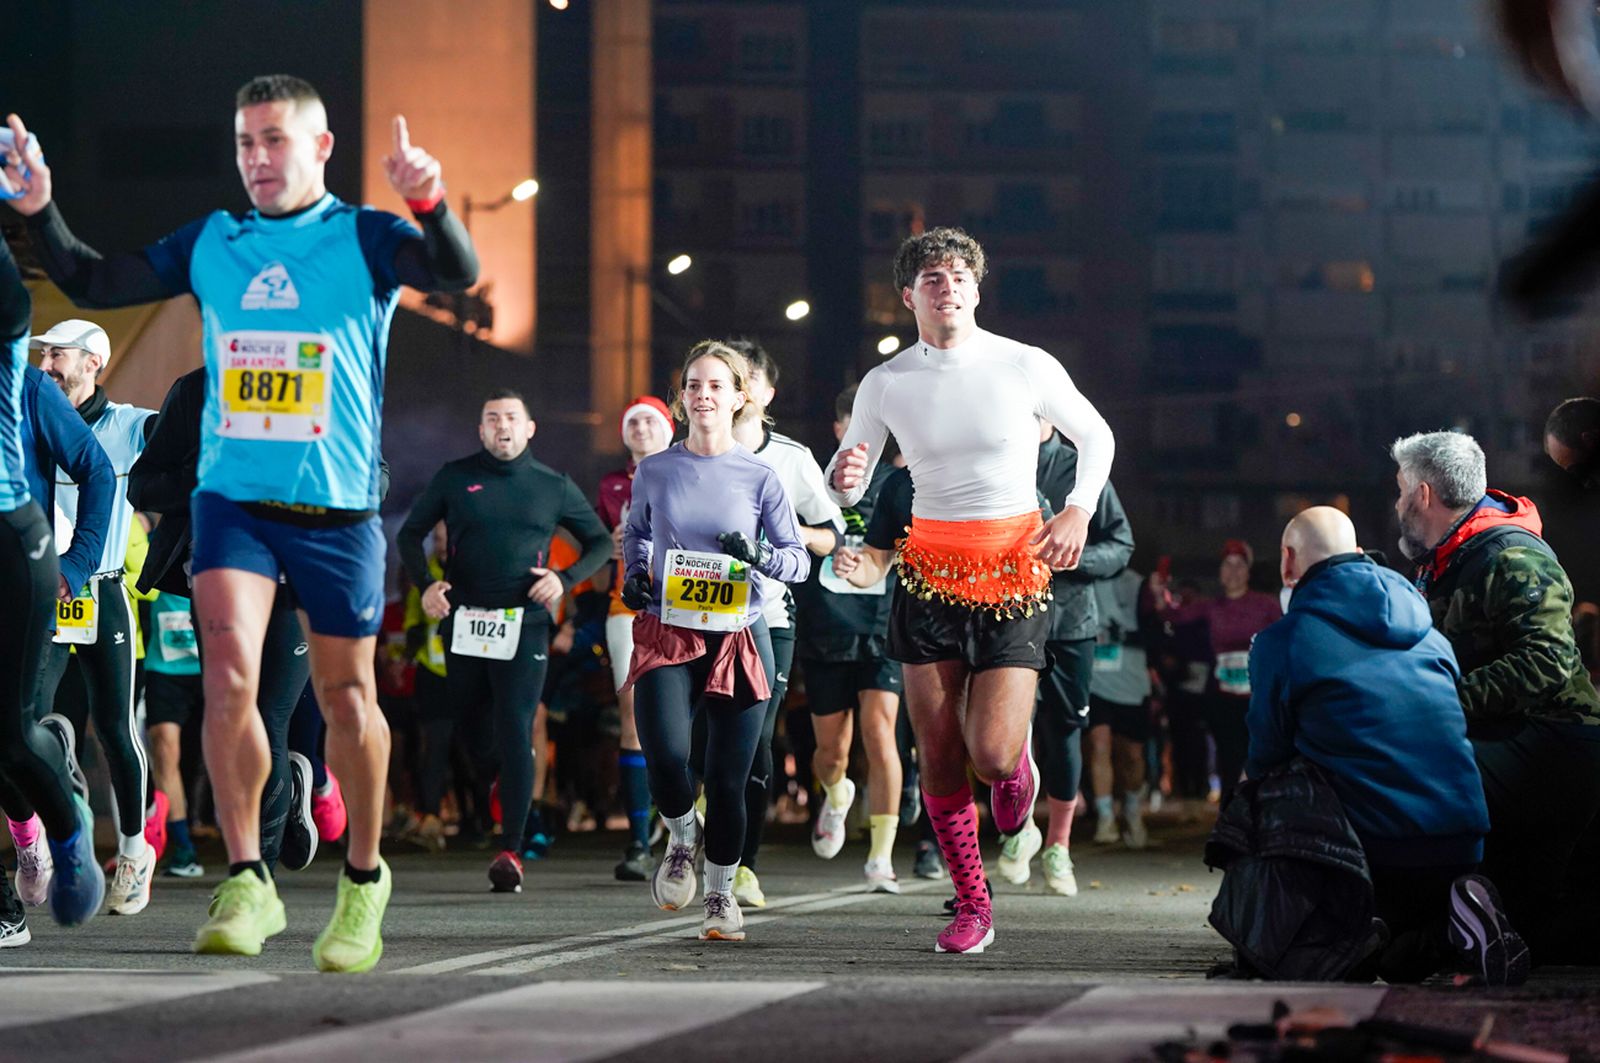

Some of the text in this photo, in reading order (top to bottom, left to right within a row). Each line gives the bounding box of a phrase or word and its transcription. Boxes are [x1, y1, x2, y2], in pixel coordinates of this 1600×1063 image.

[239, 371, 303, 403] 8871
[674, 567, 692, 577] SAN
[685, 559, 712, 569] NOCHE
[712, 562, 723, 570] DE
[680, 578, 734, 606] 2370
[469, 619, 506, 639] 1024
